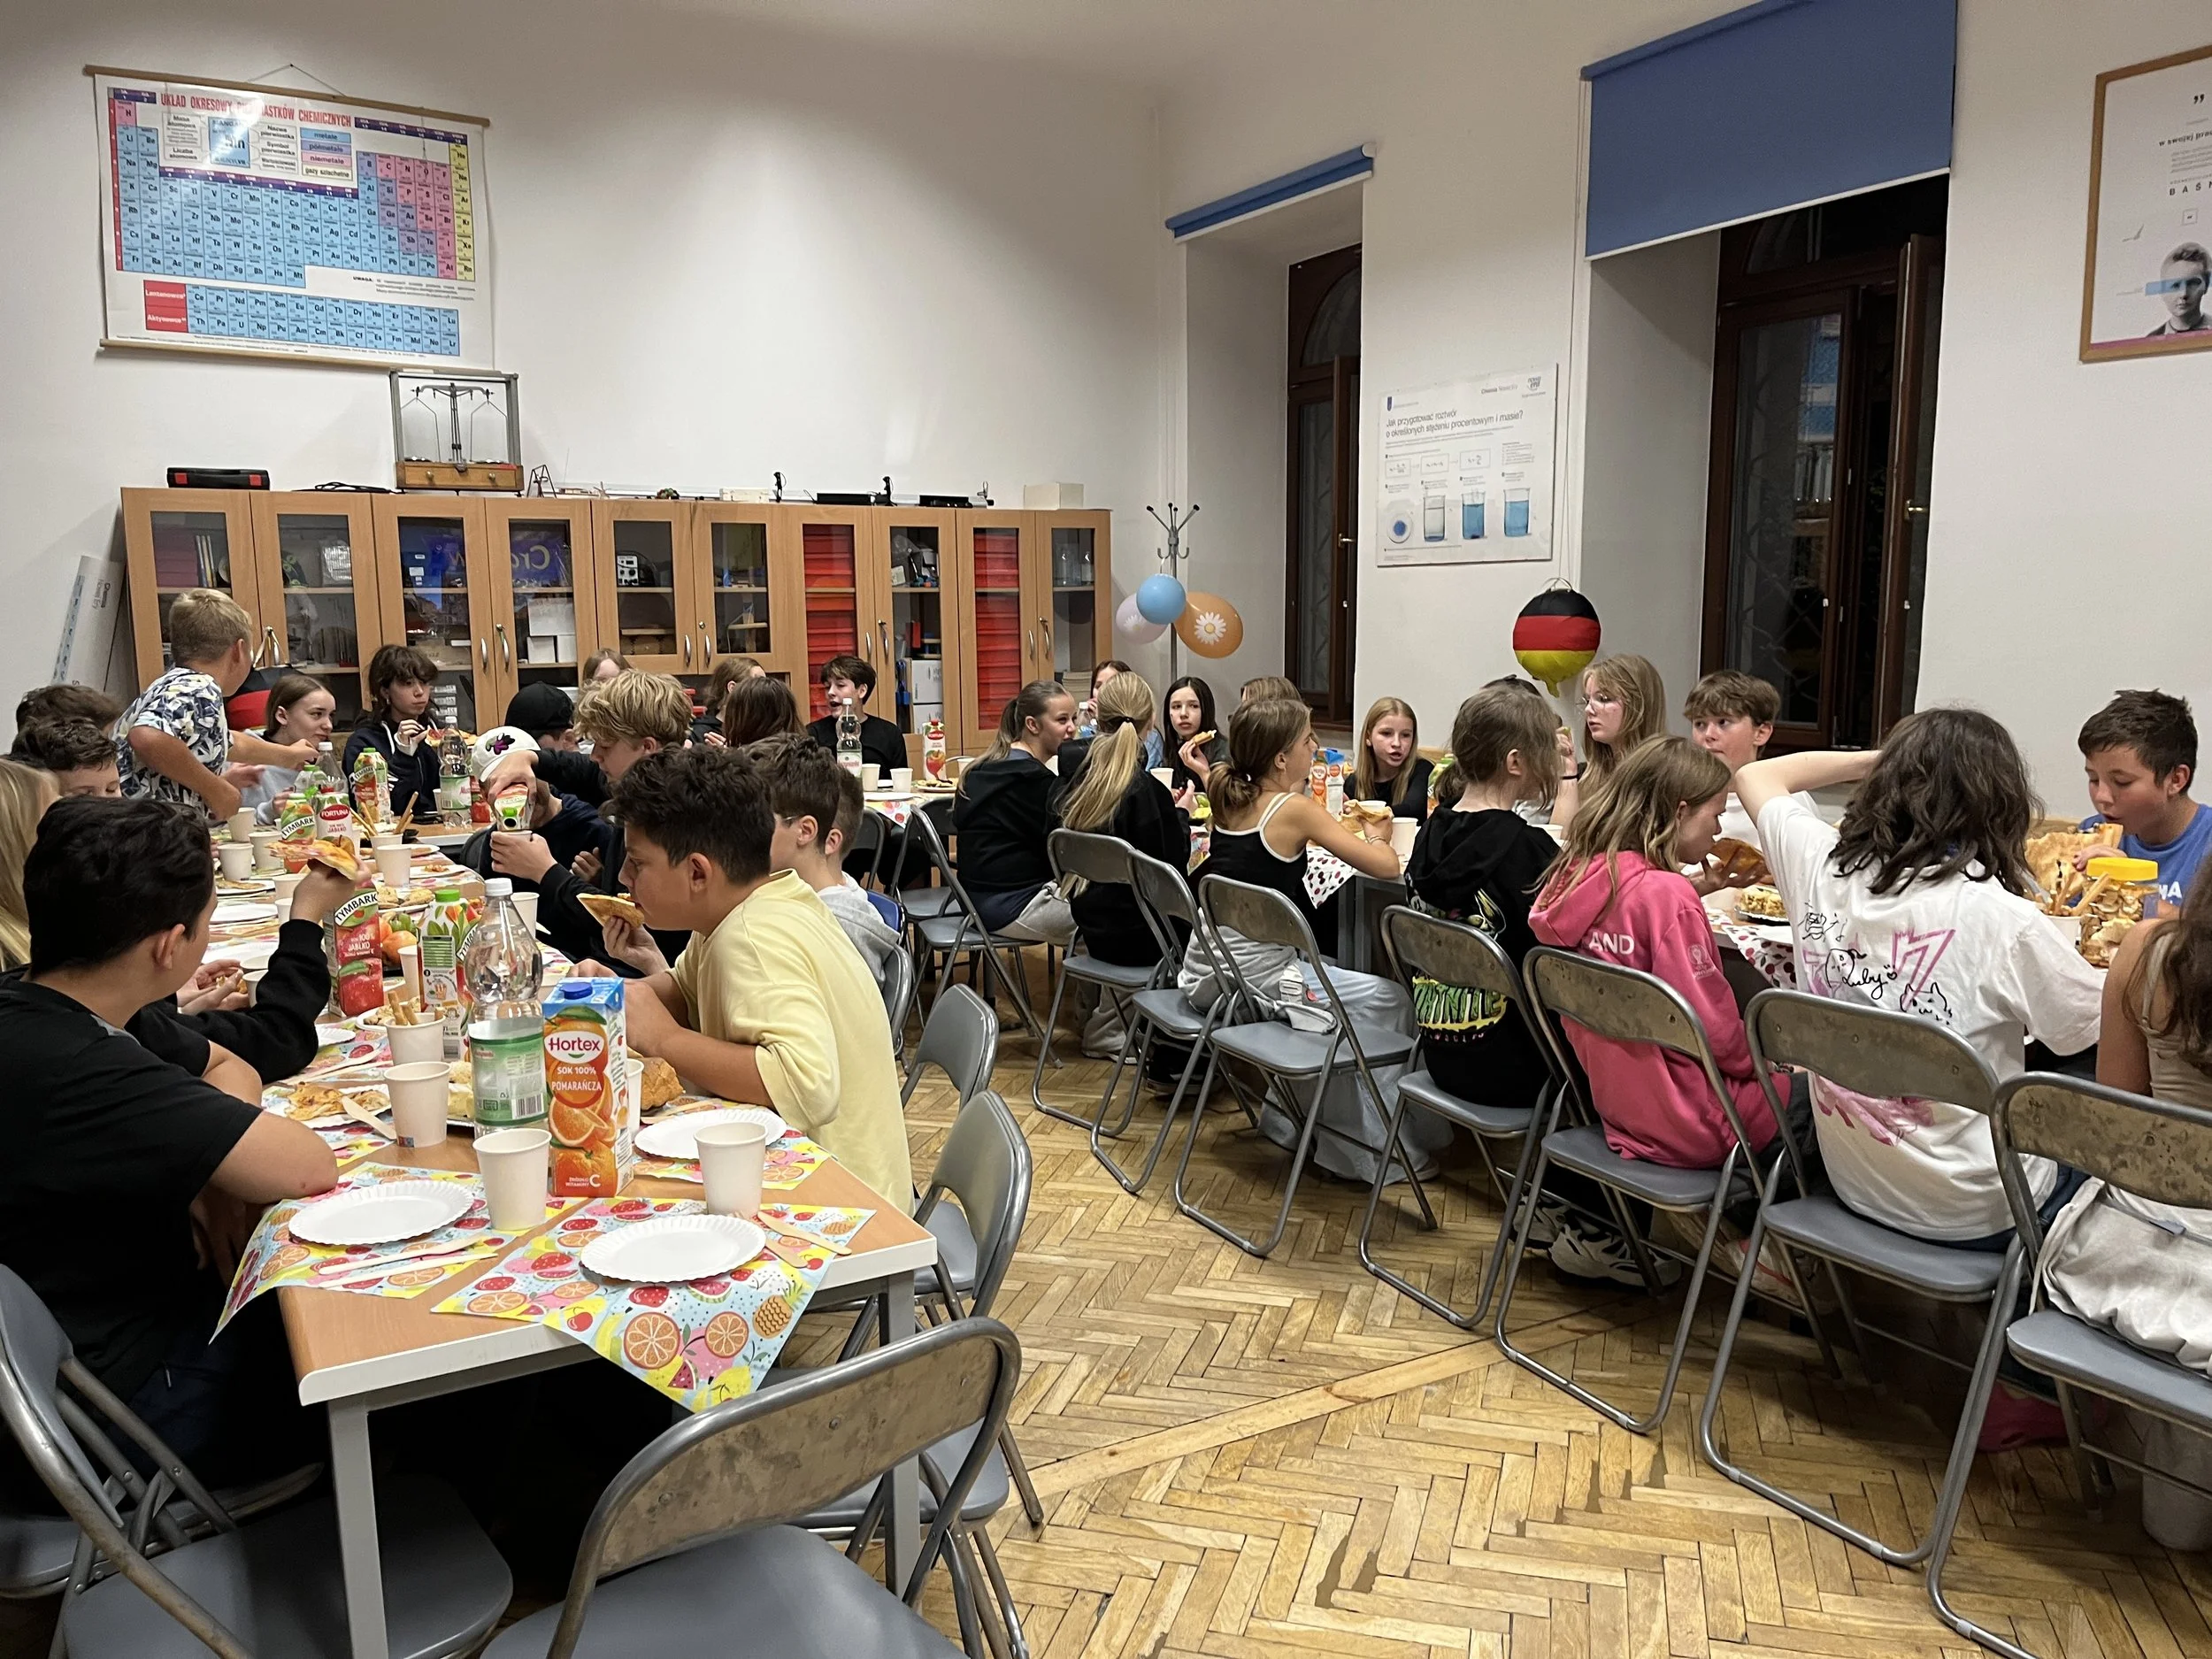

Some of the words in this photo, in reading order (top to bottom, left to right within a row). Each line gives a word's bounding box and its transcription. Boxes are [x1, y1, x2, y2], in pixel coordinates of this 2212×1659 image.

[191, 96, 232, 111] OKRESOWY
[299, 110, 350, 127] CHEMICZNYCH
[281, 818, 314, 836] TYMBARK
[335, 893, 378, 921] TYMBARK
[1588, 932, 1634, 955] AND
[549, 1037, 600, 1051] Hortex
[552, 1079, 602, 1090] POMARAŃCZA
[590, 1174, 601, 1187] C
